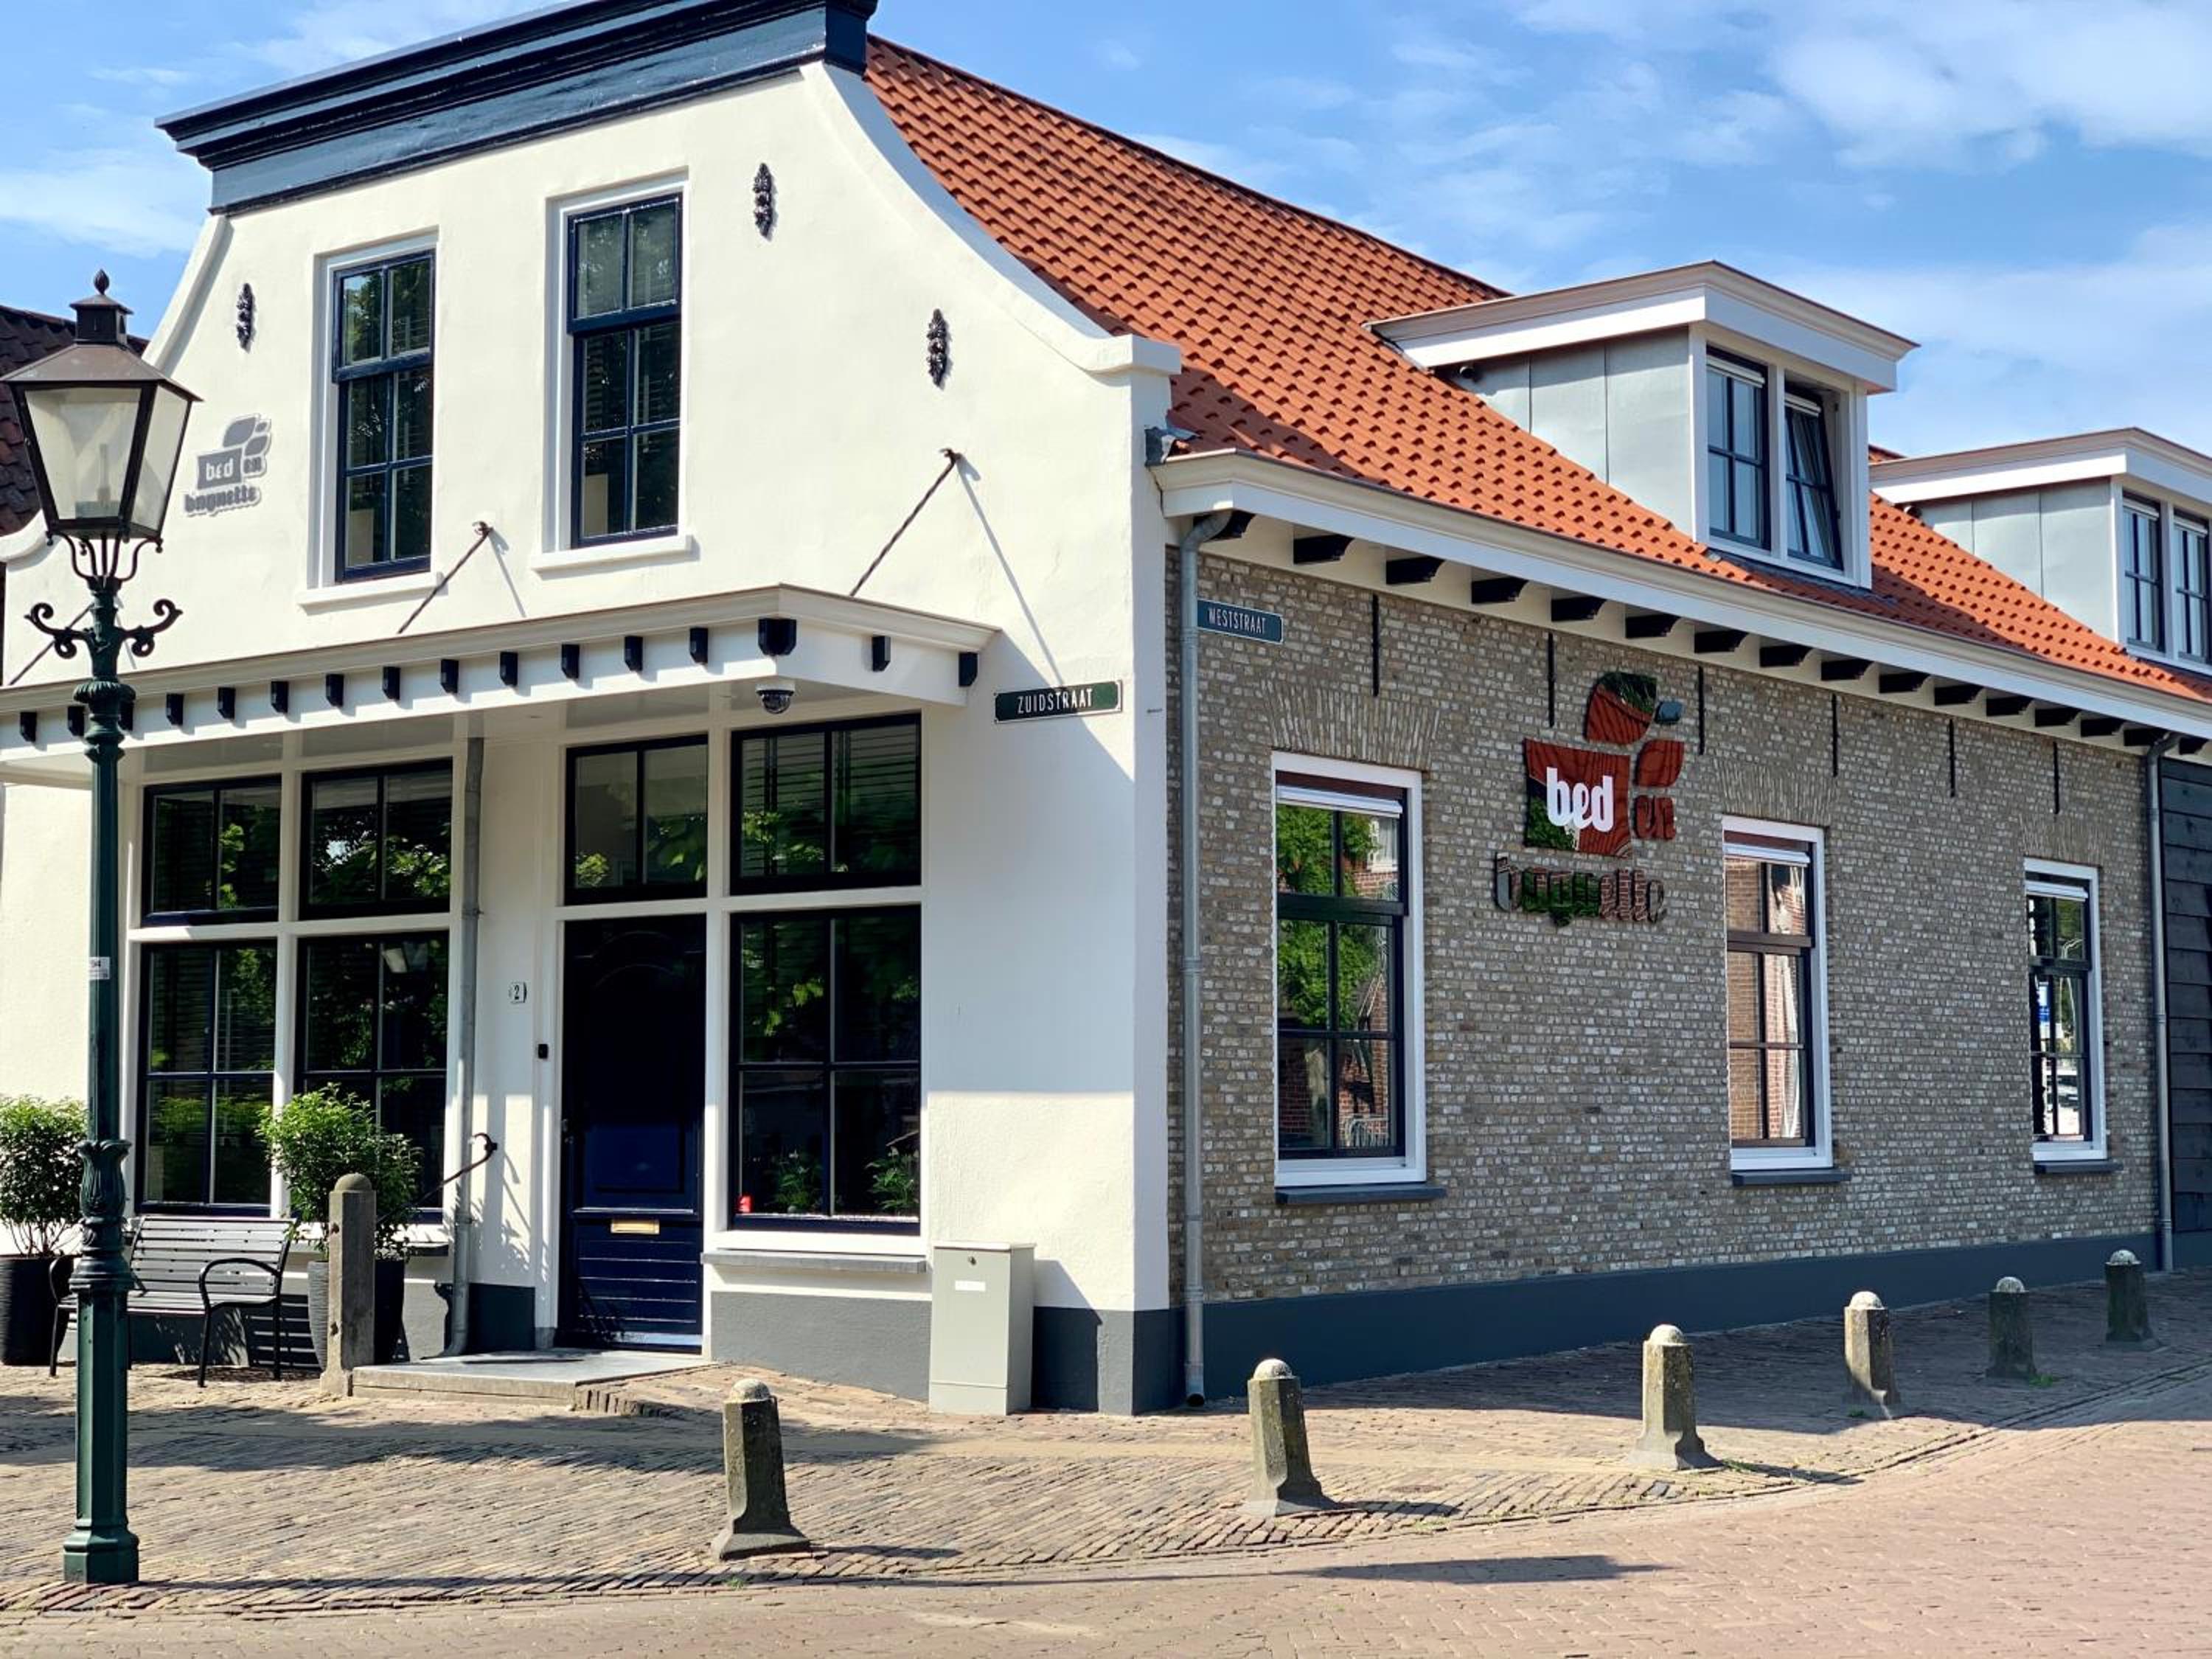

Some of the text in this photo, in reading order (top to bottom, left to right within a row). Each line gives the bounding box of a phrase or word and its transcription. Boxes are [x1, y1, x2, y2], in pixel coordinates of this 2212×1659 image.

[206, 457, 234, 481] bed
[1208, 607, 1266, 634] WESTSTRAAT
[1018, 688, 1093, 714] ZUIDSTRAAT
[1546, 766, 1677, 841] bed en
[514, 984, 520, 1001] 2
